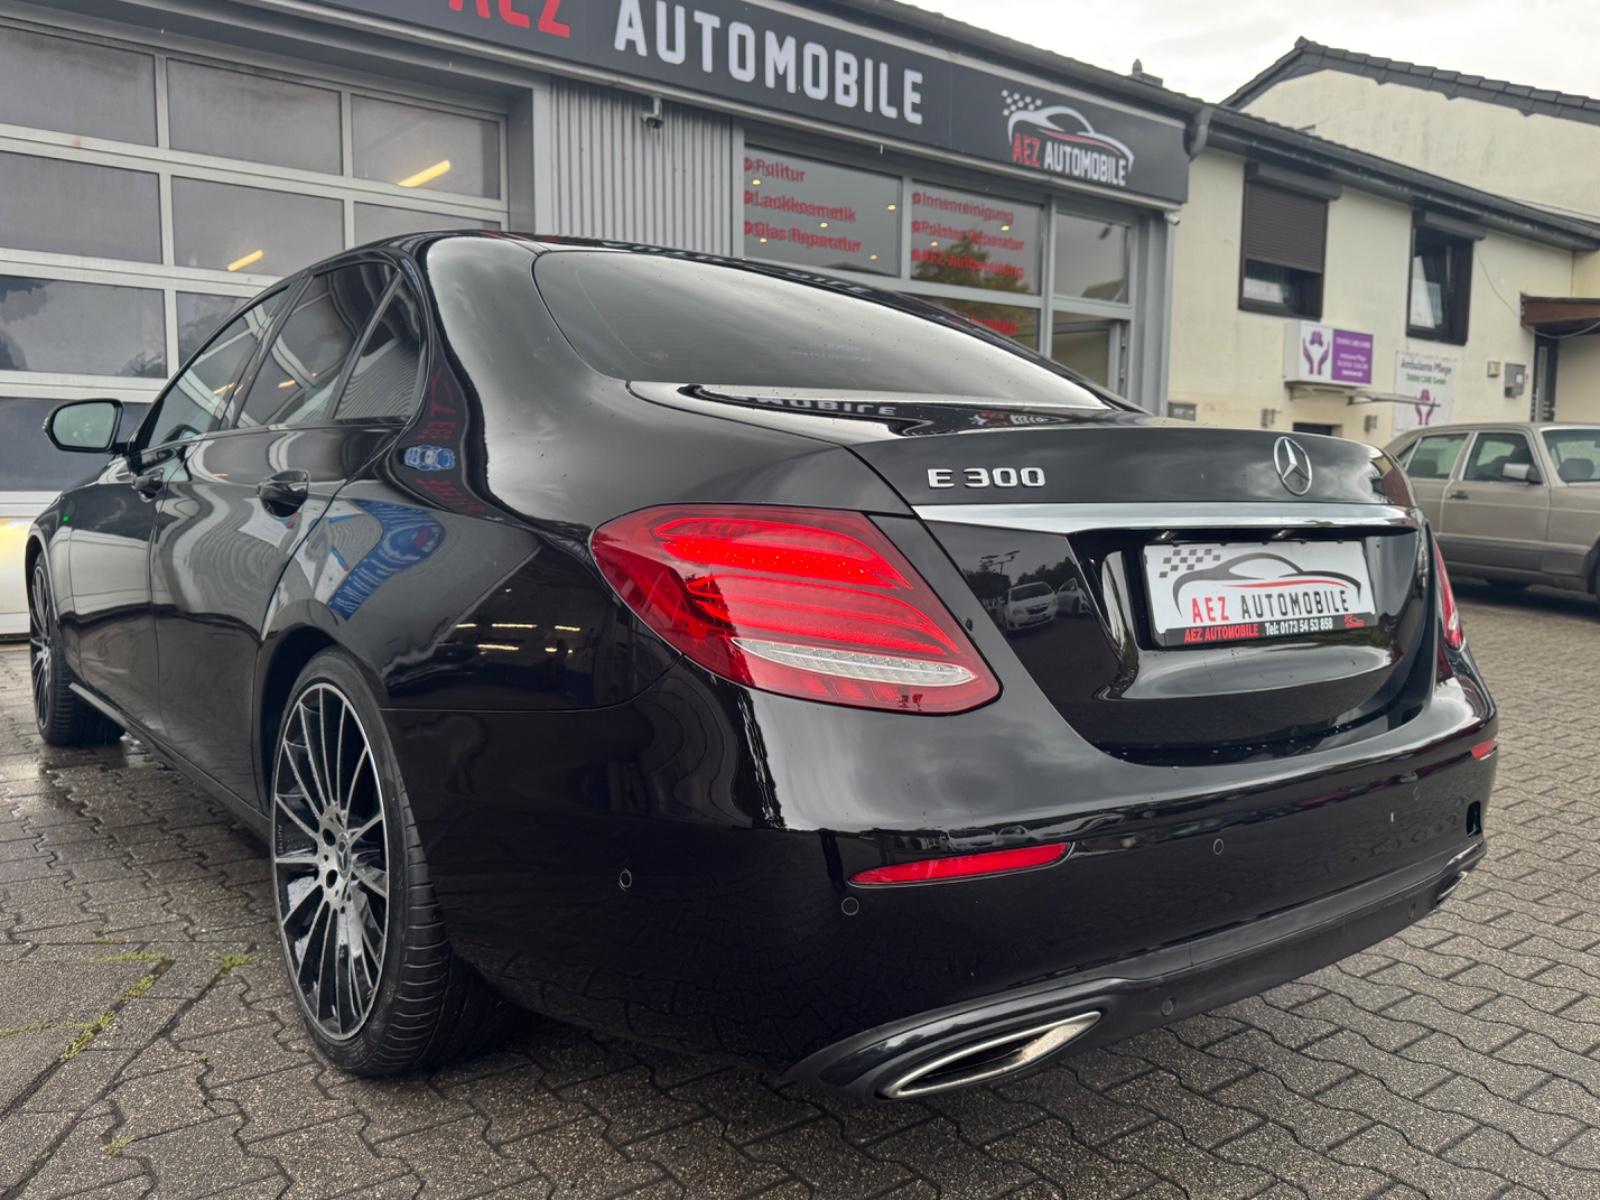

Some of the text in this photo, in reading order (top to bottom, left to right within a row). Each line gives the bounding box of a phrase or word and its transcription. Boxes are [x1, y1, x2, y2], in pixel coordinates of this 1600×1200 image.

[614, 0, 924, 125] AUTOMOBILE
[755, 158, 806, 183] Politur
[1011, 132, 1126, 187] AEZ AUTOMOBILE
[928, 467, 1046, 489] E 300
[1192, 590, 1349, 623] AEZ AUTOMOBILE
[1184, 628, 1203, 643] AEZ
[1205, 623, 1259, 641] AUTOMOBILE
[1265, 622, 1279, 635] Tel:
